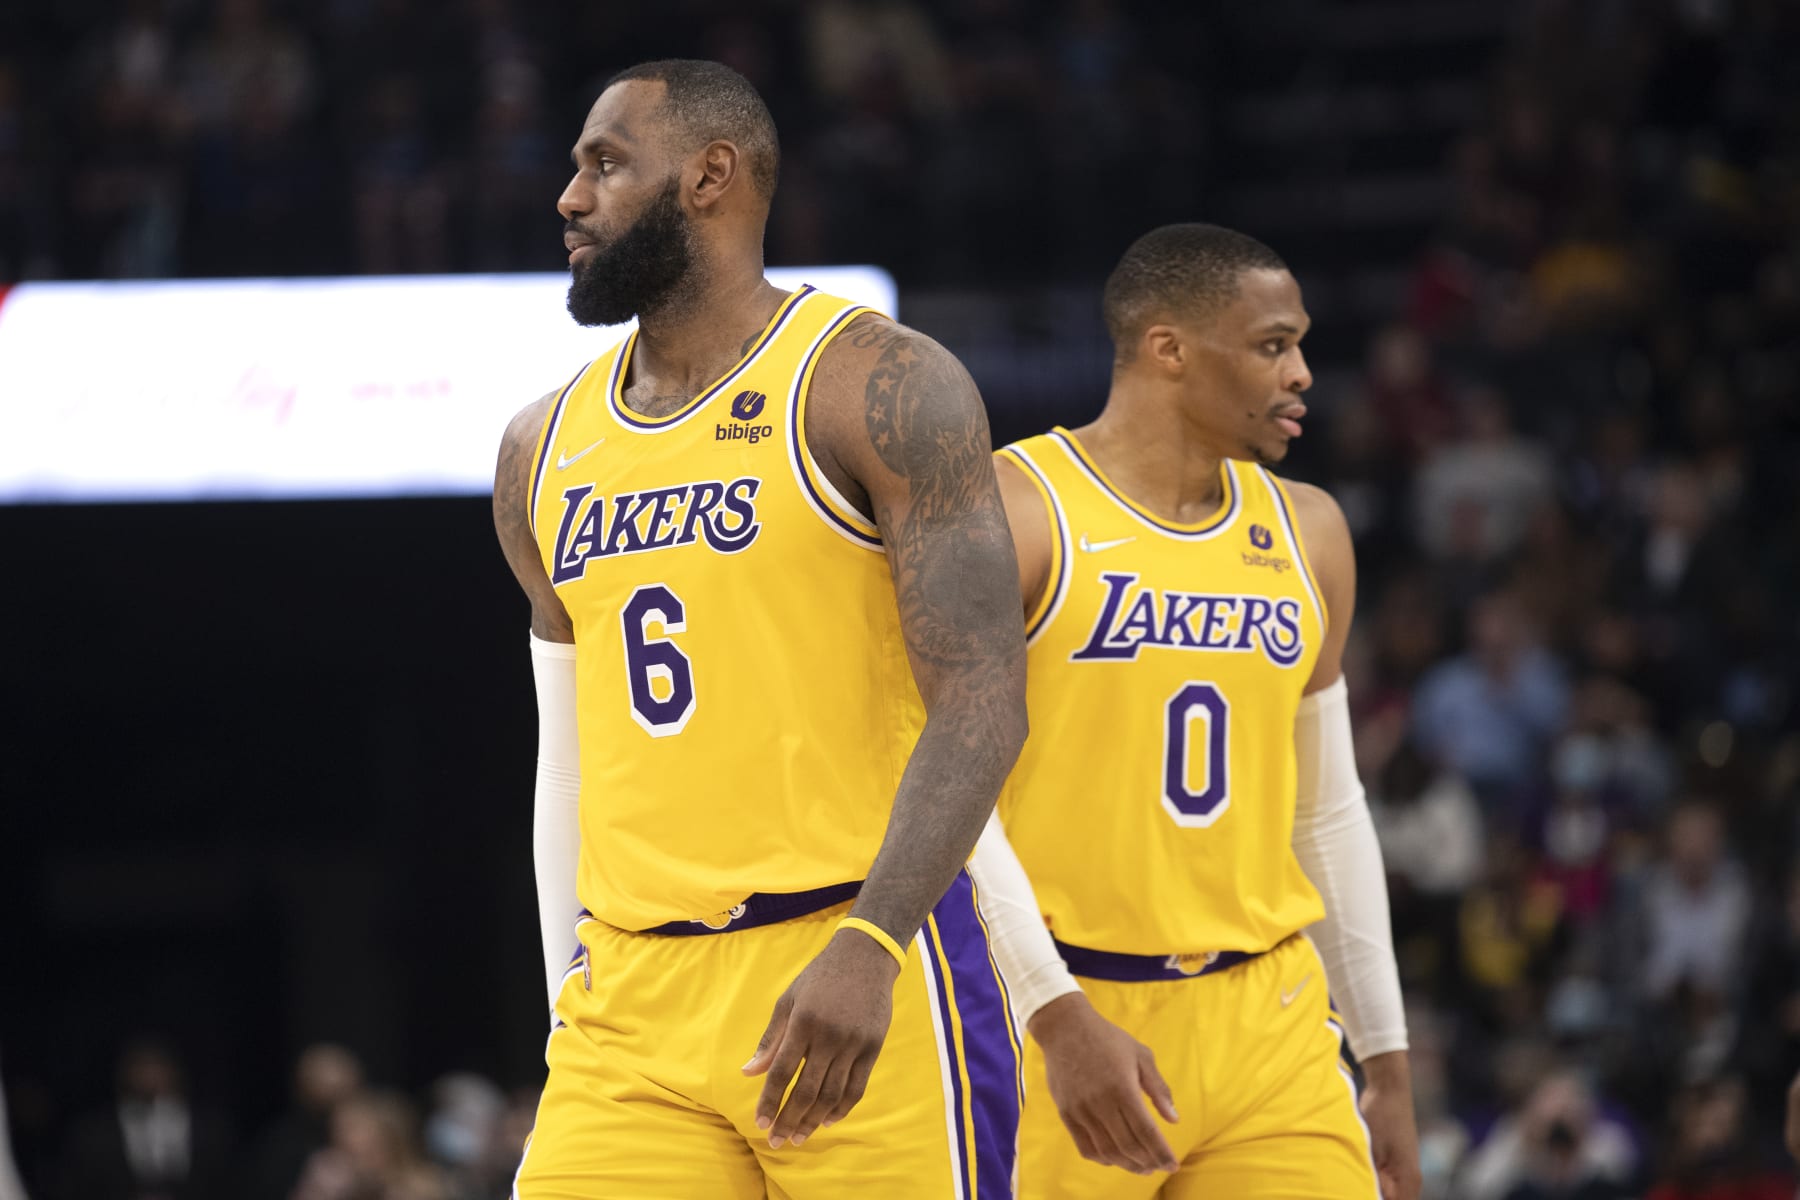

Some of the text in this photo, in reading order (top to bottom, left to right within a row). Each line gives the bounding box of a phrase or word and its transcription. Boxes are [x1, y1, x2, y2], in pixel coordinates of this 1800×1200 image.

[715, 423, 772, 443] bibigo
[551, 476, 763, 587] LAKERS
[1241, 551, 1291, 573] bibigo
[619, 582, 696, 738] 6
[1067, 570, 1304, 669] LAKERS
[1160, 680, 1230, 828] 0
